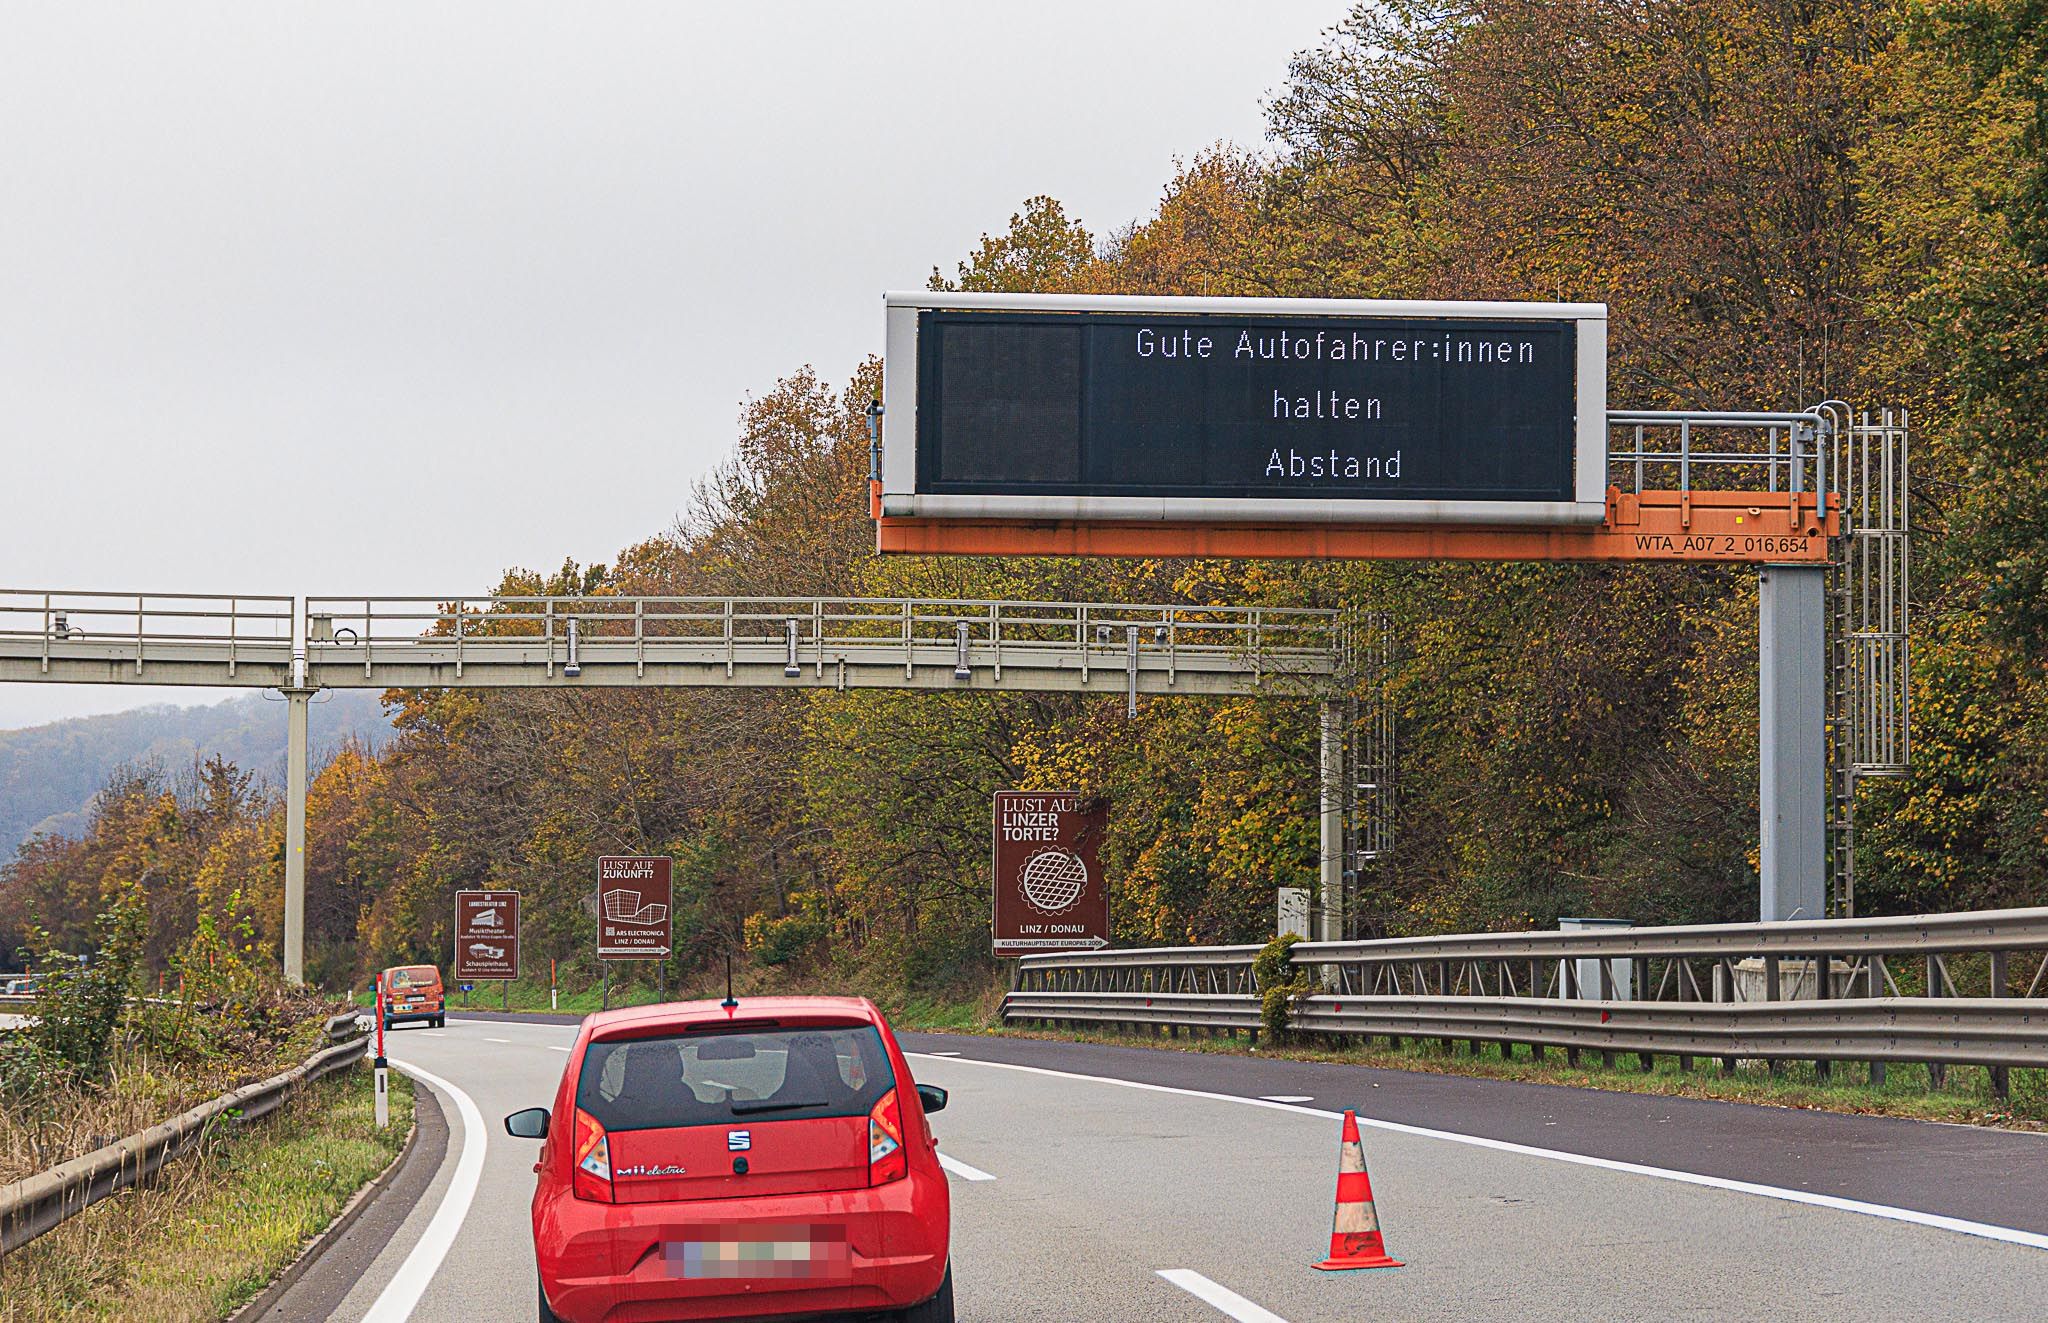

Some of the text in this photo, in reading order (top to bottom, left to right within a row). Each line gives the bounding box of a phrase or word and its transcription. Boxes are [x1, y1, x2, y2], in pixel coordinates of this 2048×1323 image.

[1136, 328, 1535, 364] Gute Autofahrer:innen
[1272, 389, 1382, 420] halten
[1265, 448, 1402, 479] Abstand
[1003, 798, 1046, 812] LUST
[1003, 812, 1059, 827] LINZER
[1002, 827, 1060, 841] TORTE?
[603, 861, 655, 870] LUST AUF
[602, 870, 654, 879] ZUKUNFT?
[1020, 925, 1042, 934] LINZ
[1050, 925, 1085, 934] DONAU
